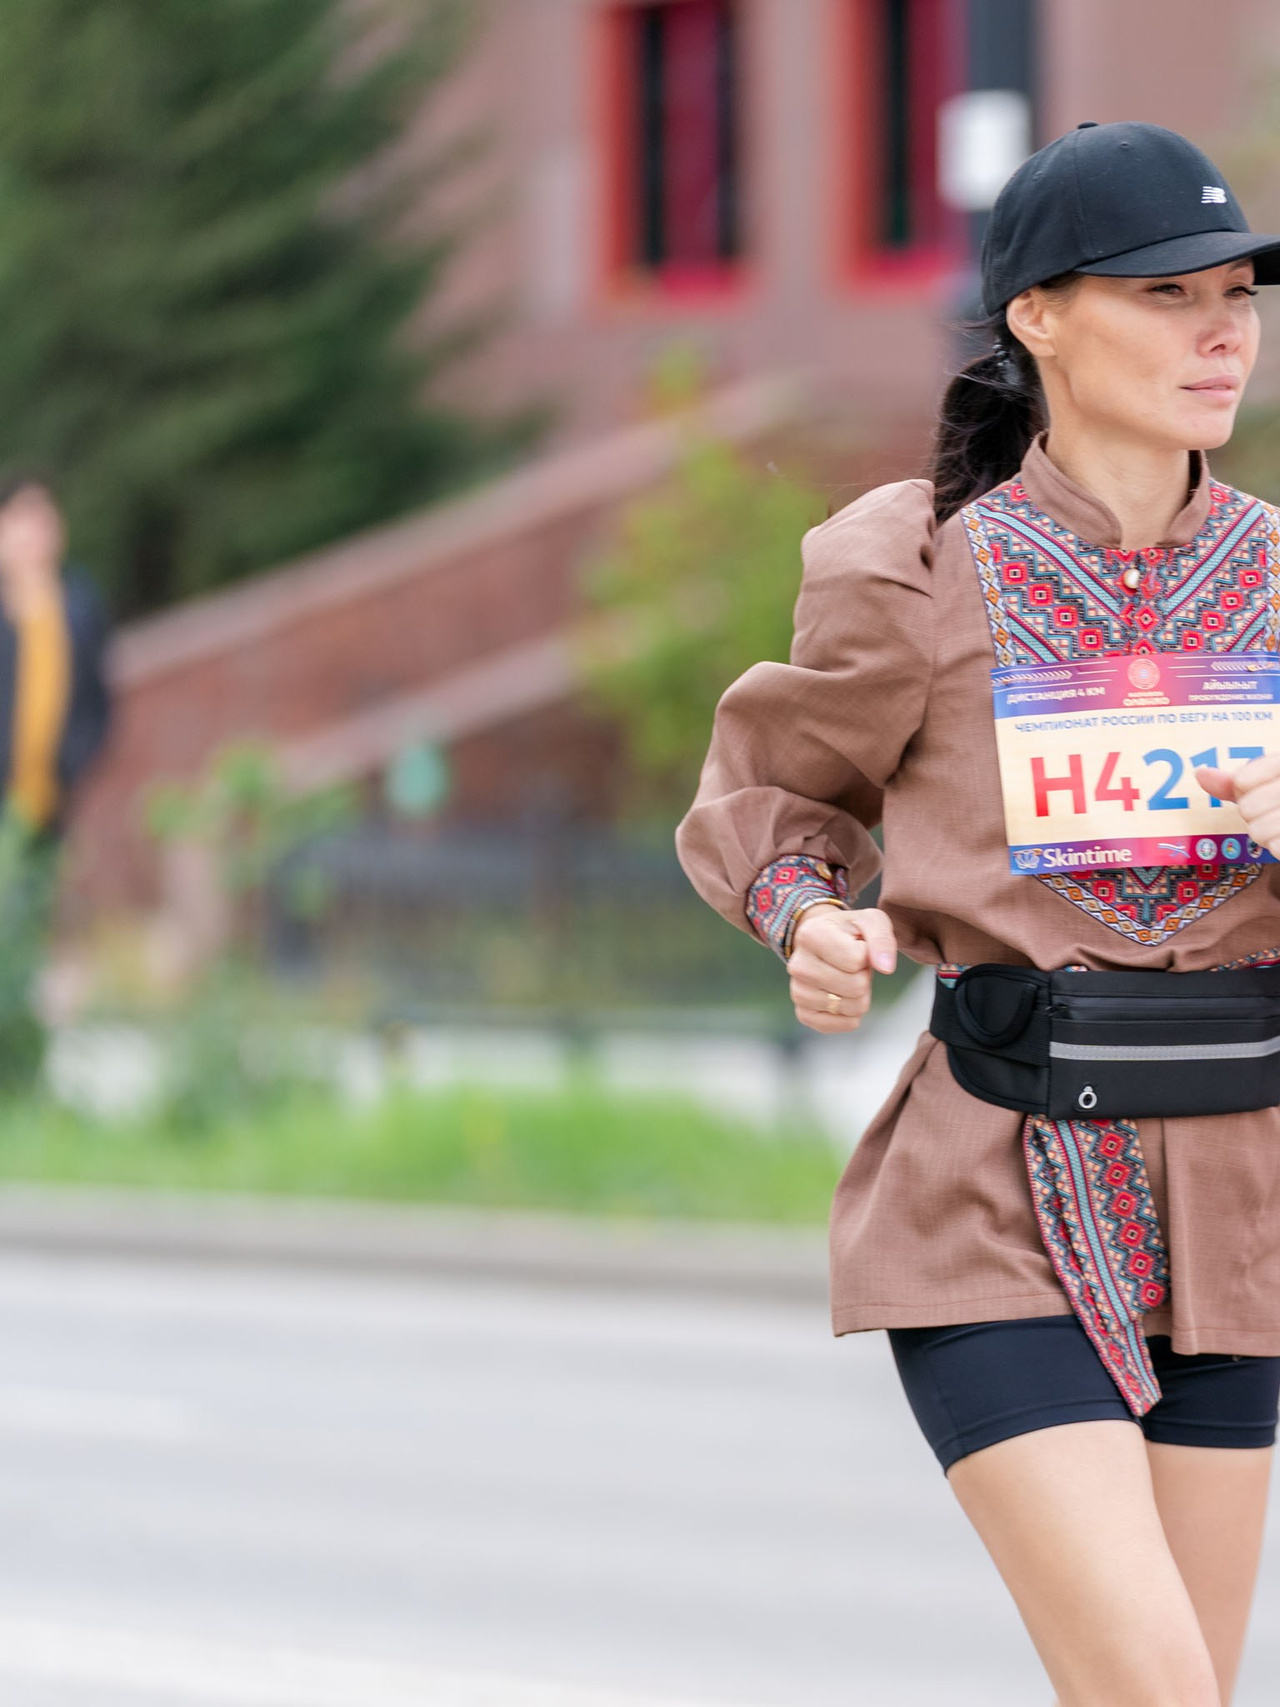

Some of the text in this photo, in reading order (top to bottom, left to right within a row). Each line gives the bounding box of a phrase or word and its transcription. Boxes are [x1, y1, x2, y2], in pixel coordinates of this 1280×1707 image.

[1006, 688, 1078, 705] ДИСТАНЦИЯ
[1086, 686, 1106, 697] КМ
[1014, 711, 1274, 732] ЧЕМПИОНАТ РОССИИ ПО БЕГУ НА 100 КМ
[1042, 845, 1132, 868] Skintime
